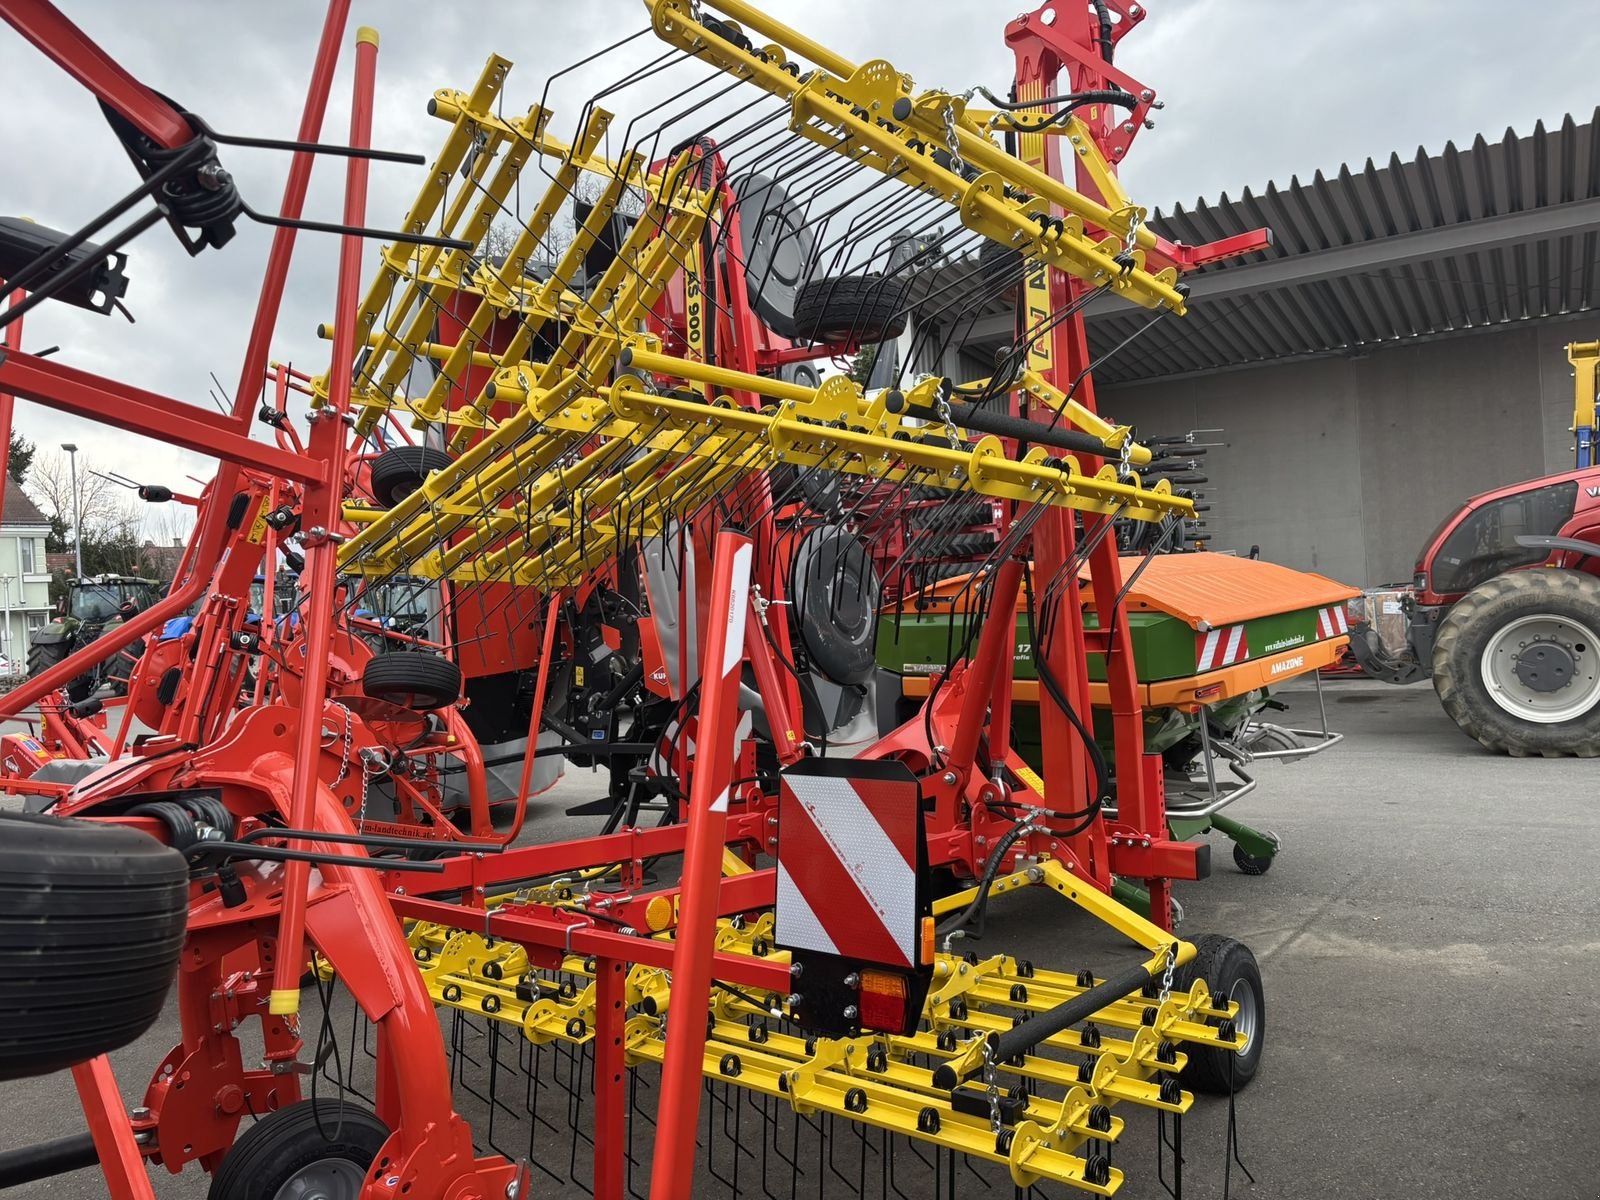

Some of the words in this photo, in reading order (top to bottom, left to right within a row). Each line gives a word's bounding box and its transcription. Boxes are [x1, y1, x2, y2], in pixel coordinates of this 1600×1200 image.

[688, 302, 700, 342] 900
[1017, 644, 1031, 653] 17
[1271, 656, 1303, 674] AMAZONE
